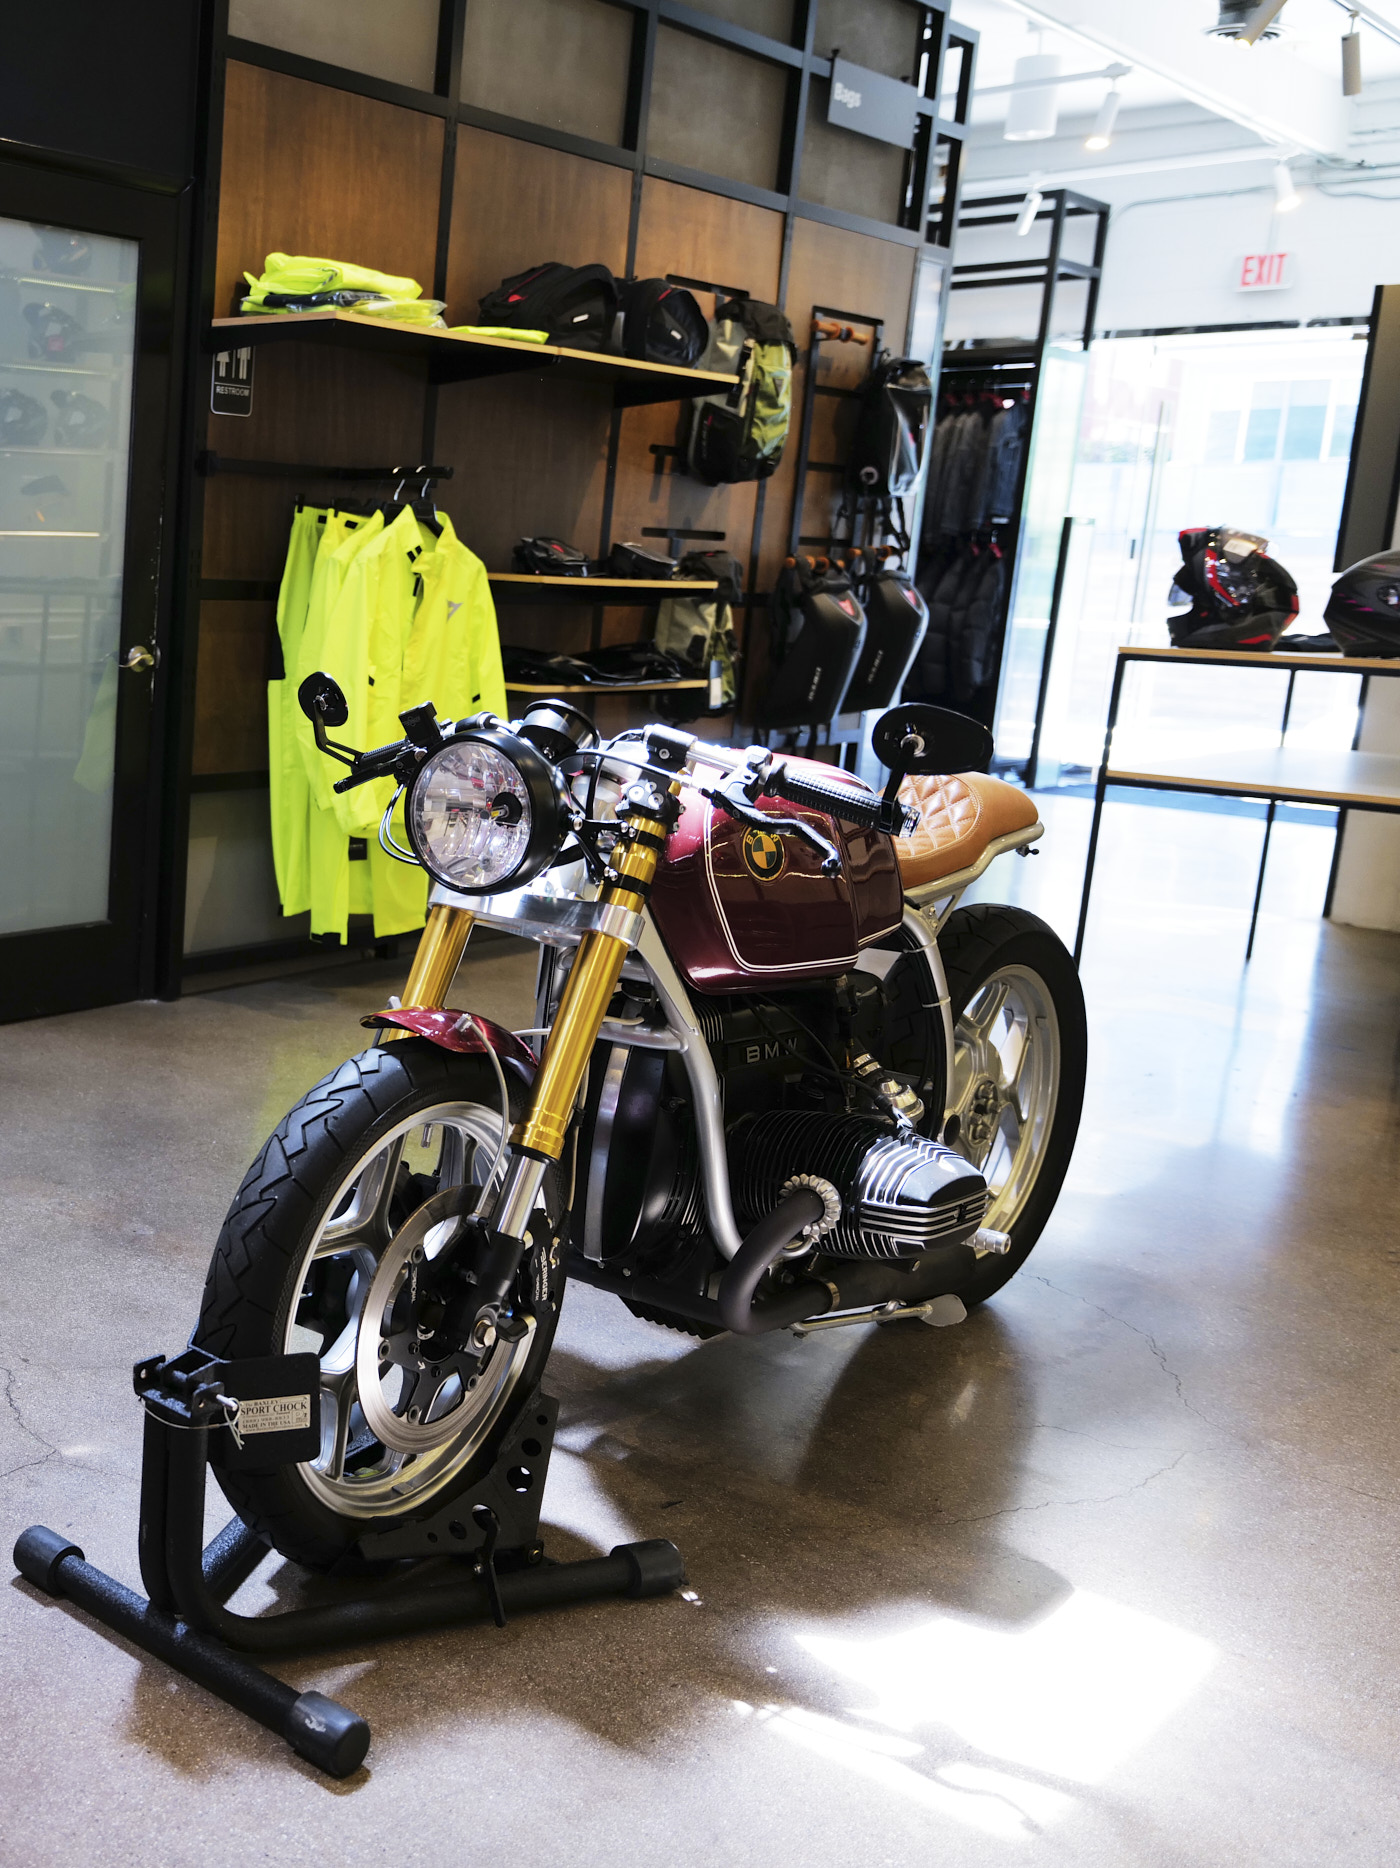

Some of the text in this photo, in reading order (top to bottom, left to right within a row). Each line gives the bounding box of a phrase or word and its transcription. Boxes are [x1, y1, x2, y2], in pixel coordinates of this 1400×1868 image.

[834, 82, 862, 108] Bags
[1240, 253, 1288, 287] EXIT
[215, 385, 250, 397] RESTROOM
[746, 1037, 797, 1063] BMW
[540, 1246, 549, 1301] BERINGER
[241, 1406, 271, 1416] SPORT
[273, 1402, 307, 1412] CHOCK
